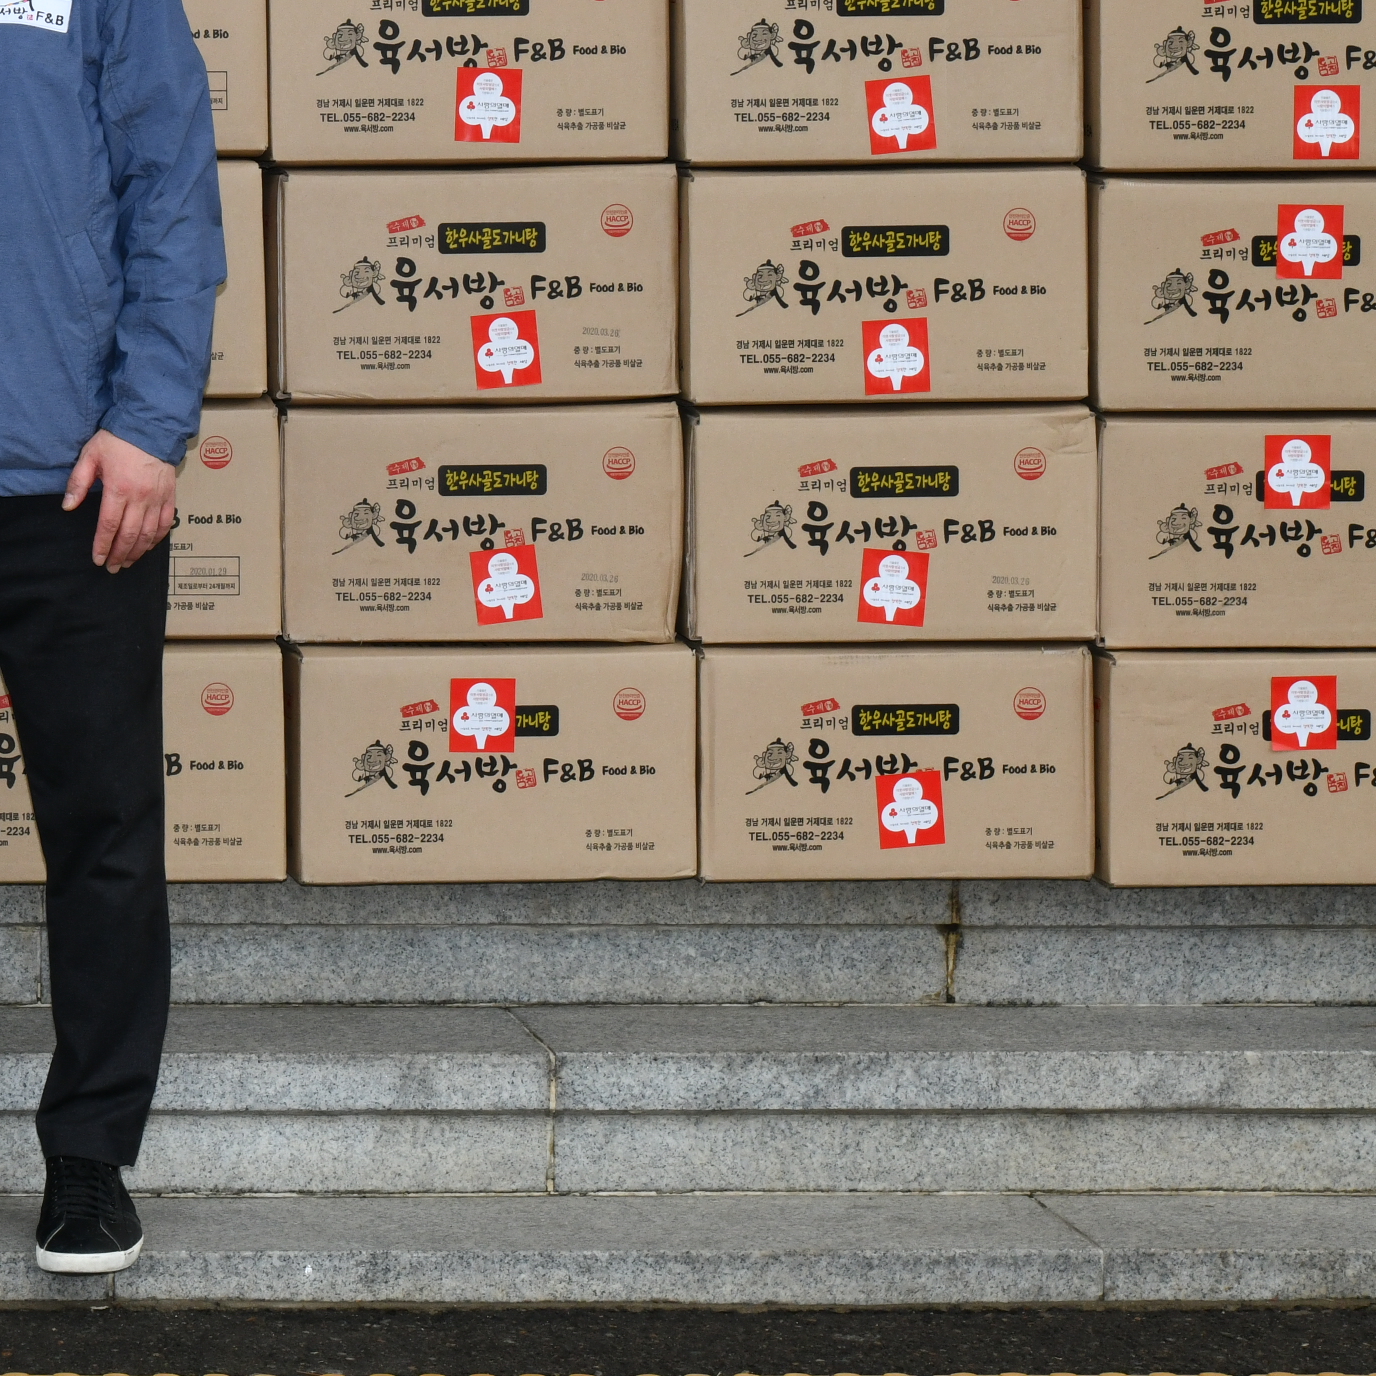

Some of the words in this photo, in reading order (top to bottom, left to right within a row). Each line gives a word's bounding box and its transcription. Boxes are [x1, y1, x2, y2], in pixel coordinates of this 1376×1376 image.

[36, 10, 65, 26] F&B
[1204, 26, 1319, 82] 육서방
[849, 230, 941, 253] 한우사골도가니탕
[944, 518, 996, 544] F&B
[748, 593, 844, 604] TEL.055-682-2234
[1213, 743, 1328, 799] 육서방
